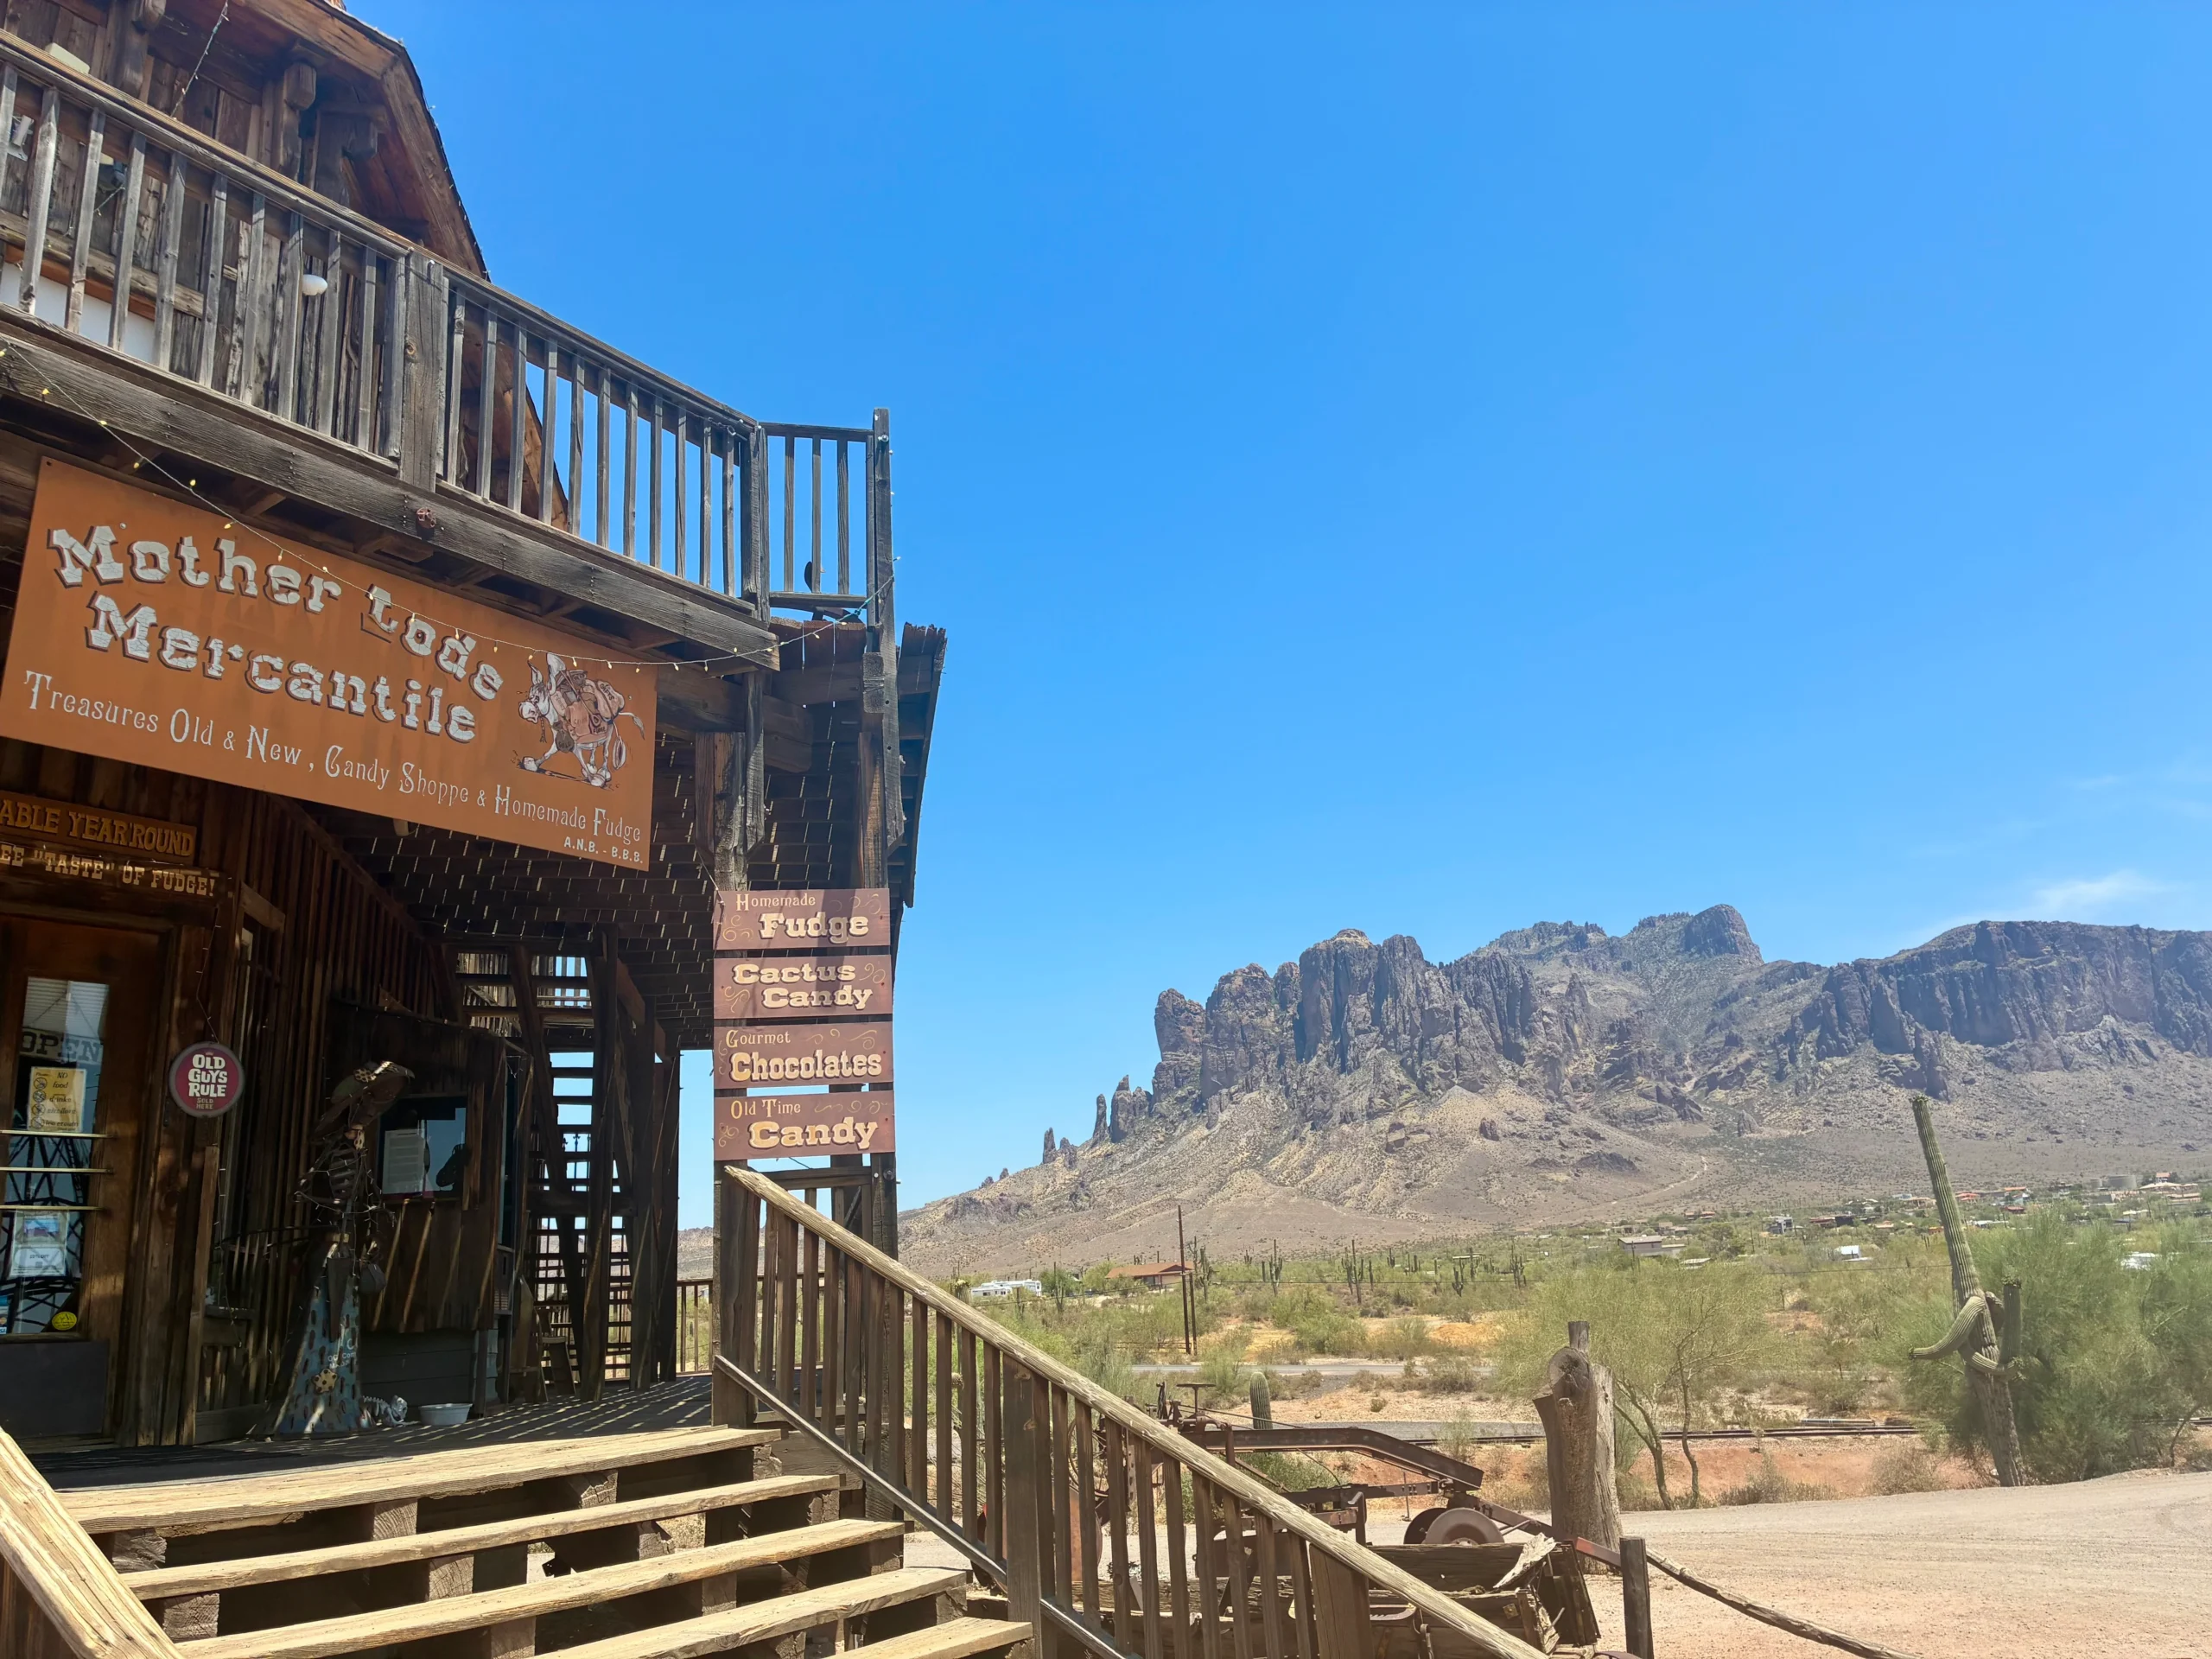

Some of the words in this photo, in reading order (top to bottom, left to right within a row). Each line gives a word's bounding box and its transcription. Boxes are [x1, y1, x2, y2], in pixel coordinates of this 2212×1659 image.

[48, 525, 342, 613] Mother
[85, 591, 475, 743] Mercantile
[24, 671, 159, 733] Treasures
[170, 708, 214, 746] Old
[224, 731, 235, 751] &
[324, 744, 391, 791] Candy
[399, 761, 469, 806] Shoppe
[476, 788, 487, 808] &
[494, 784, 587, 830] Homemade
[592, 807, 640, 845] Fudge
[122, 865, 145, 887] OF
[150, 868, 215, 897] FUDGE!
[735, 893, 816, 912] Homemade
[758, 912, 869, 944] Fudge
[732, 962, 857, 985] Cactus
[761, 984, 874, 1011] Candy
[22, 1031, 101, 1063] OPEN
[725, 1029, 791, 1048] Gourmet
[188, 1068, 228, 1084] GUYS
[192, 1053, 226, 1070] OLD
[729, 1049, 882, 1082] Chocolates
[188, 1082, 227, 1097] RULE
[730, 1099, 757, 1120] Old
[761, 1098, 802, 1118] Time
[747, 1116, 879, 1150] Candy
